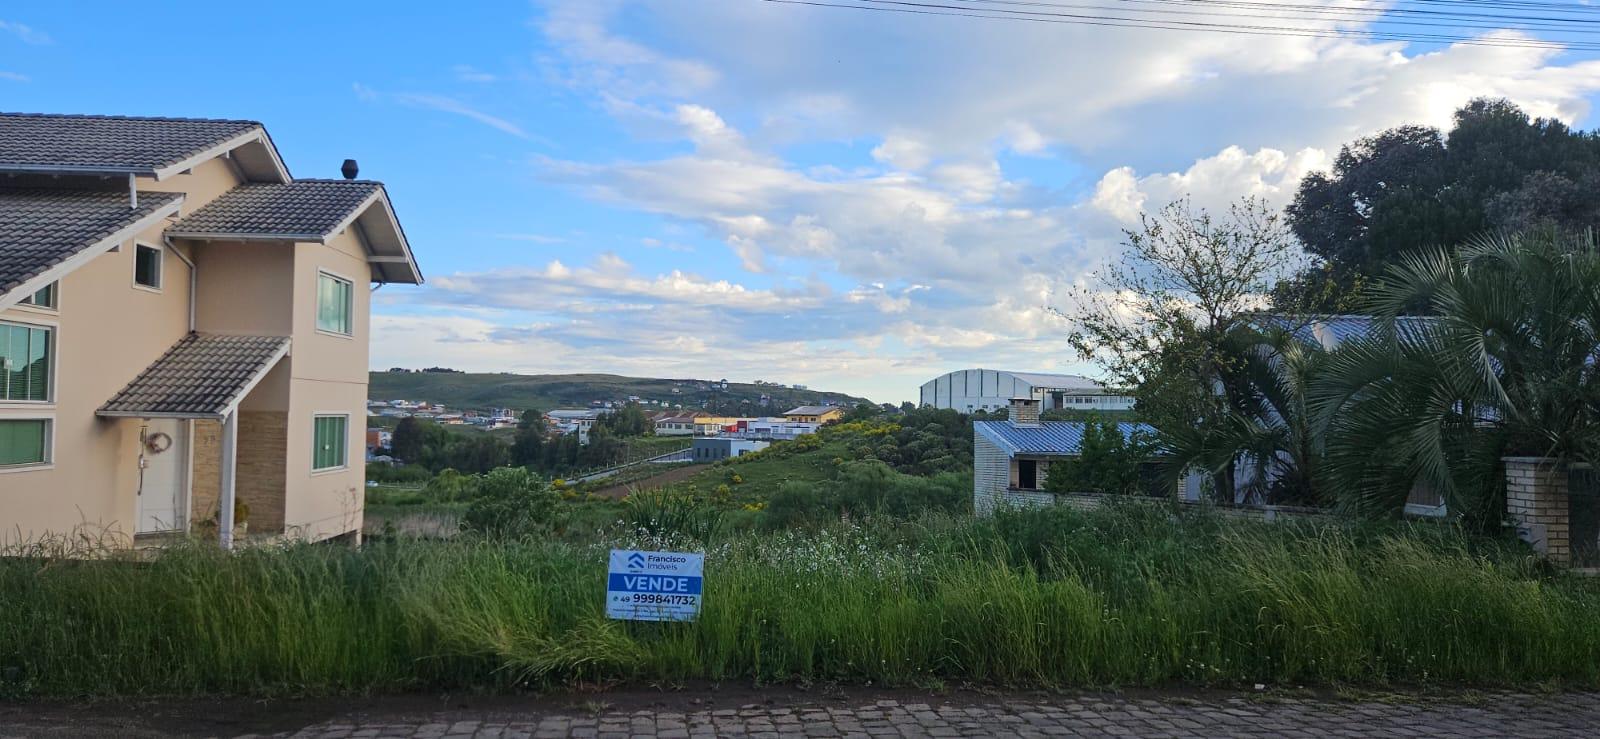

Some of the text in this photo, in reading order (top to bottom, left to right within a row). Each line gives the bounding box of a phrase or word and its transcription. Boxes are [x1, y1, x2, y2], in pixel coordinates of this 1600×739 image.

[648, 555, 686, 563] Francisco
[624, 576, 688, 592] VENDE
[633, 593, 696, 606] 999841732
